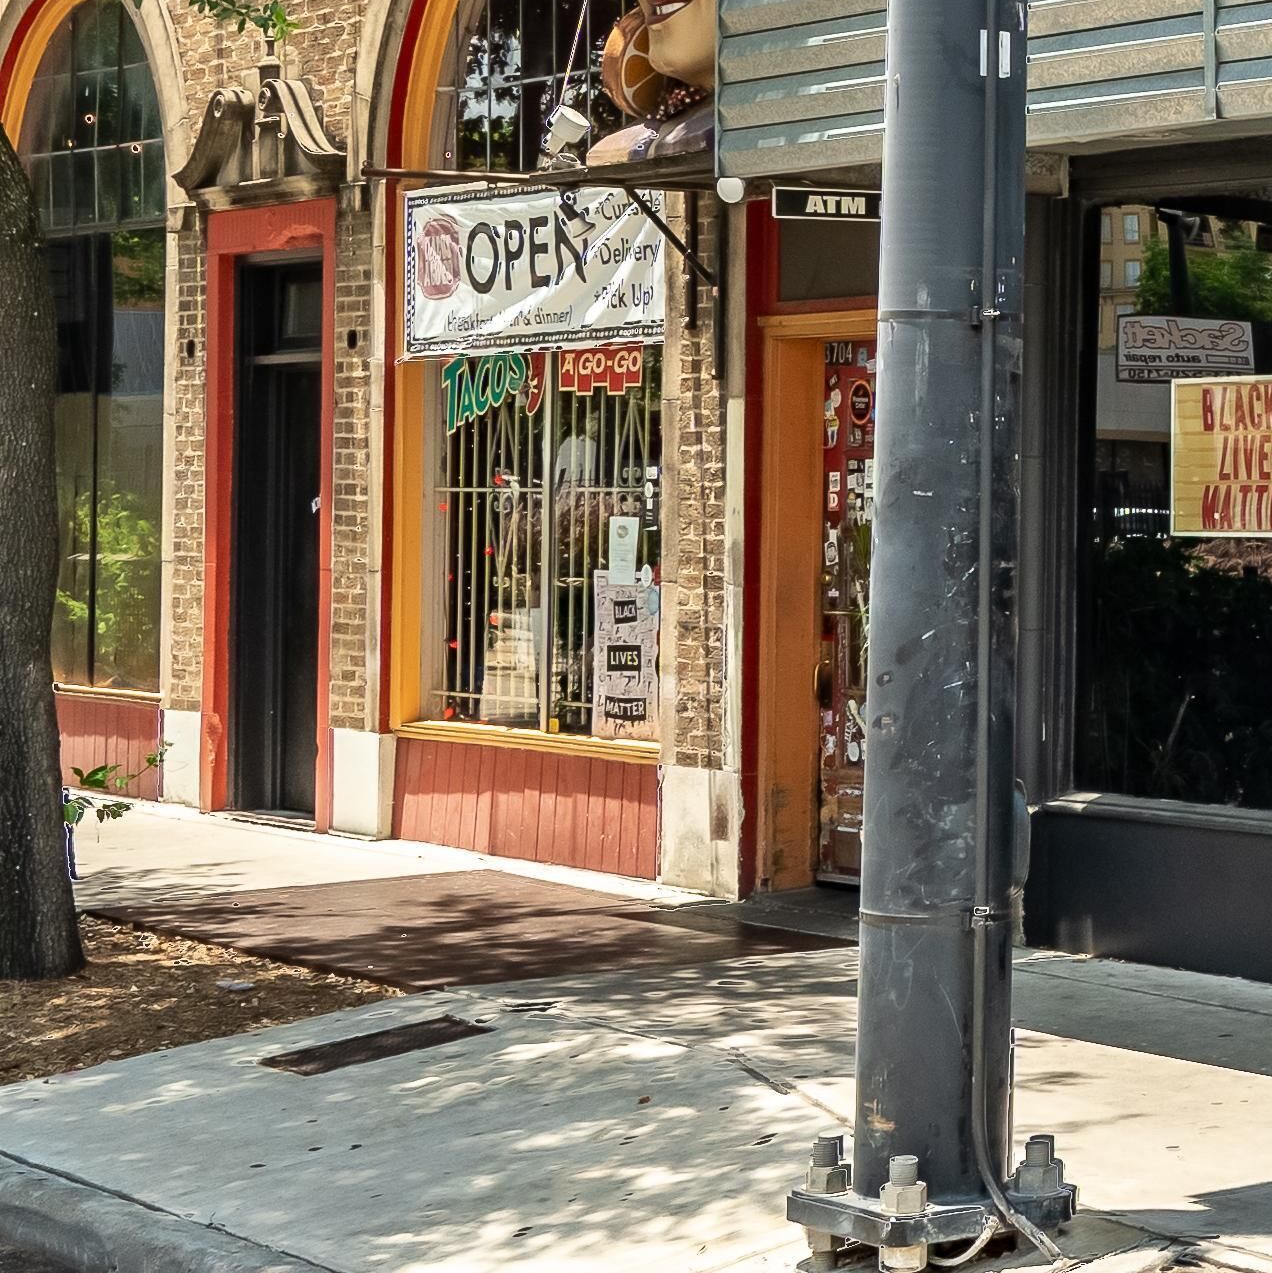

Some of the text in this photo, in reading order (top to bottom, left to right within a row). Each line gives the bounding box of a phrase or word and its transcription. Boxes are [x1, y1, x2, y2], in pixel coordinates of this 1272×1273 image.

[805, 195, 866, 215] ATM
[466, 210, 588, 294] OPEN
[561, 350, 641, 374] A GO-GO
[442, 353, 526, 436] TACOS
[615, 604, 637, 618] BLACK
[610, 651, 639, 665] LIVES
[605, 701, 645, 718] MATTER
